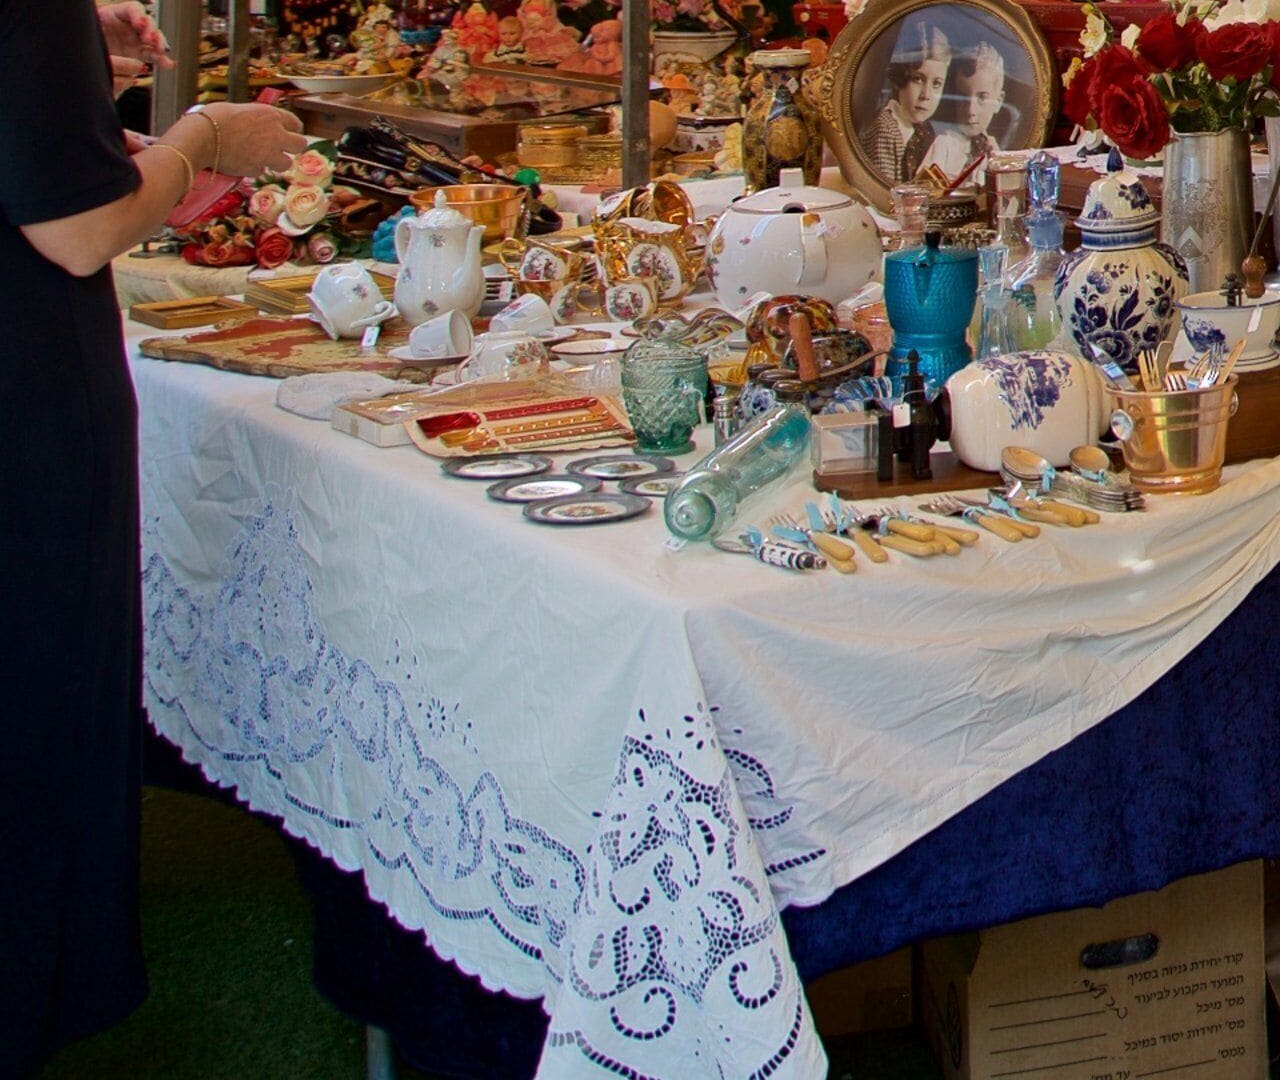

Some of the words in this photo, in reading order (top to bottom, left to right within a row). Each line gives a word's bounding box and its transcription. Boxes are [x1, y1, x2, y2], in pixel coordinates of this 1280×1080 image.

[1190, 957, 1222, 972] יחידת
[1224, 952, 1244, 965] קוד
[1210, 975, 1244, 988] המועד
[1173, 982, 1208, 997] הקבוע
[1196, 1001, 1222, 1014] מיכל
[1159, 1031, 1183, 1043] יסוד
[1187, 1024, 1222, 1038] יחידות
[1124, 1037, 1157, 1052] במיכל
